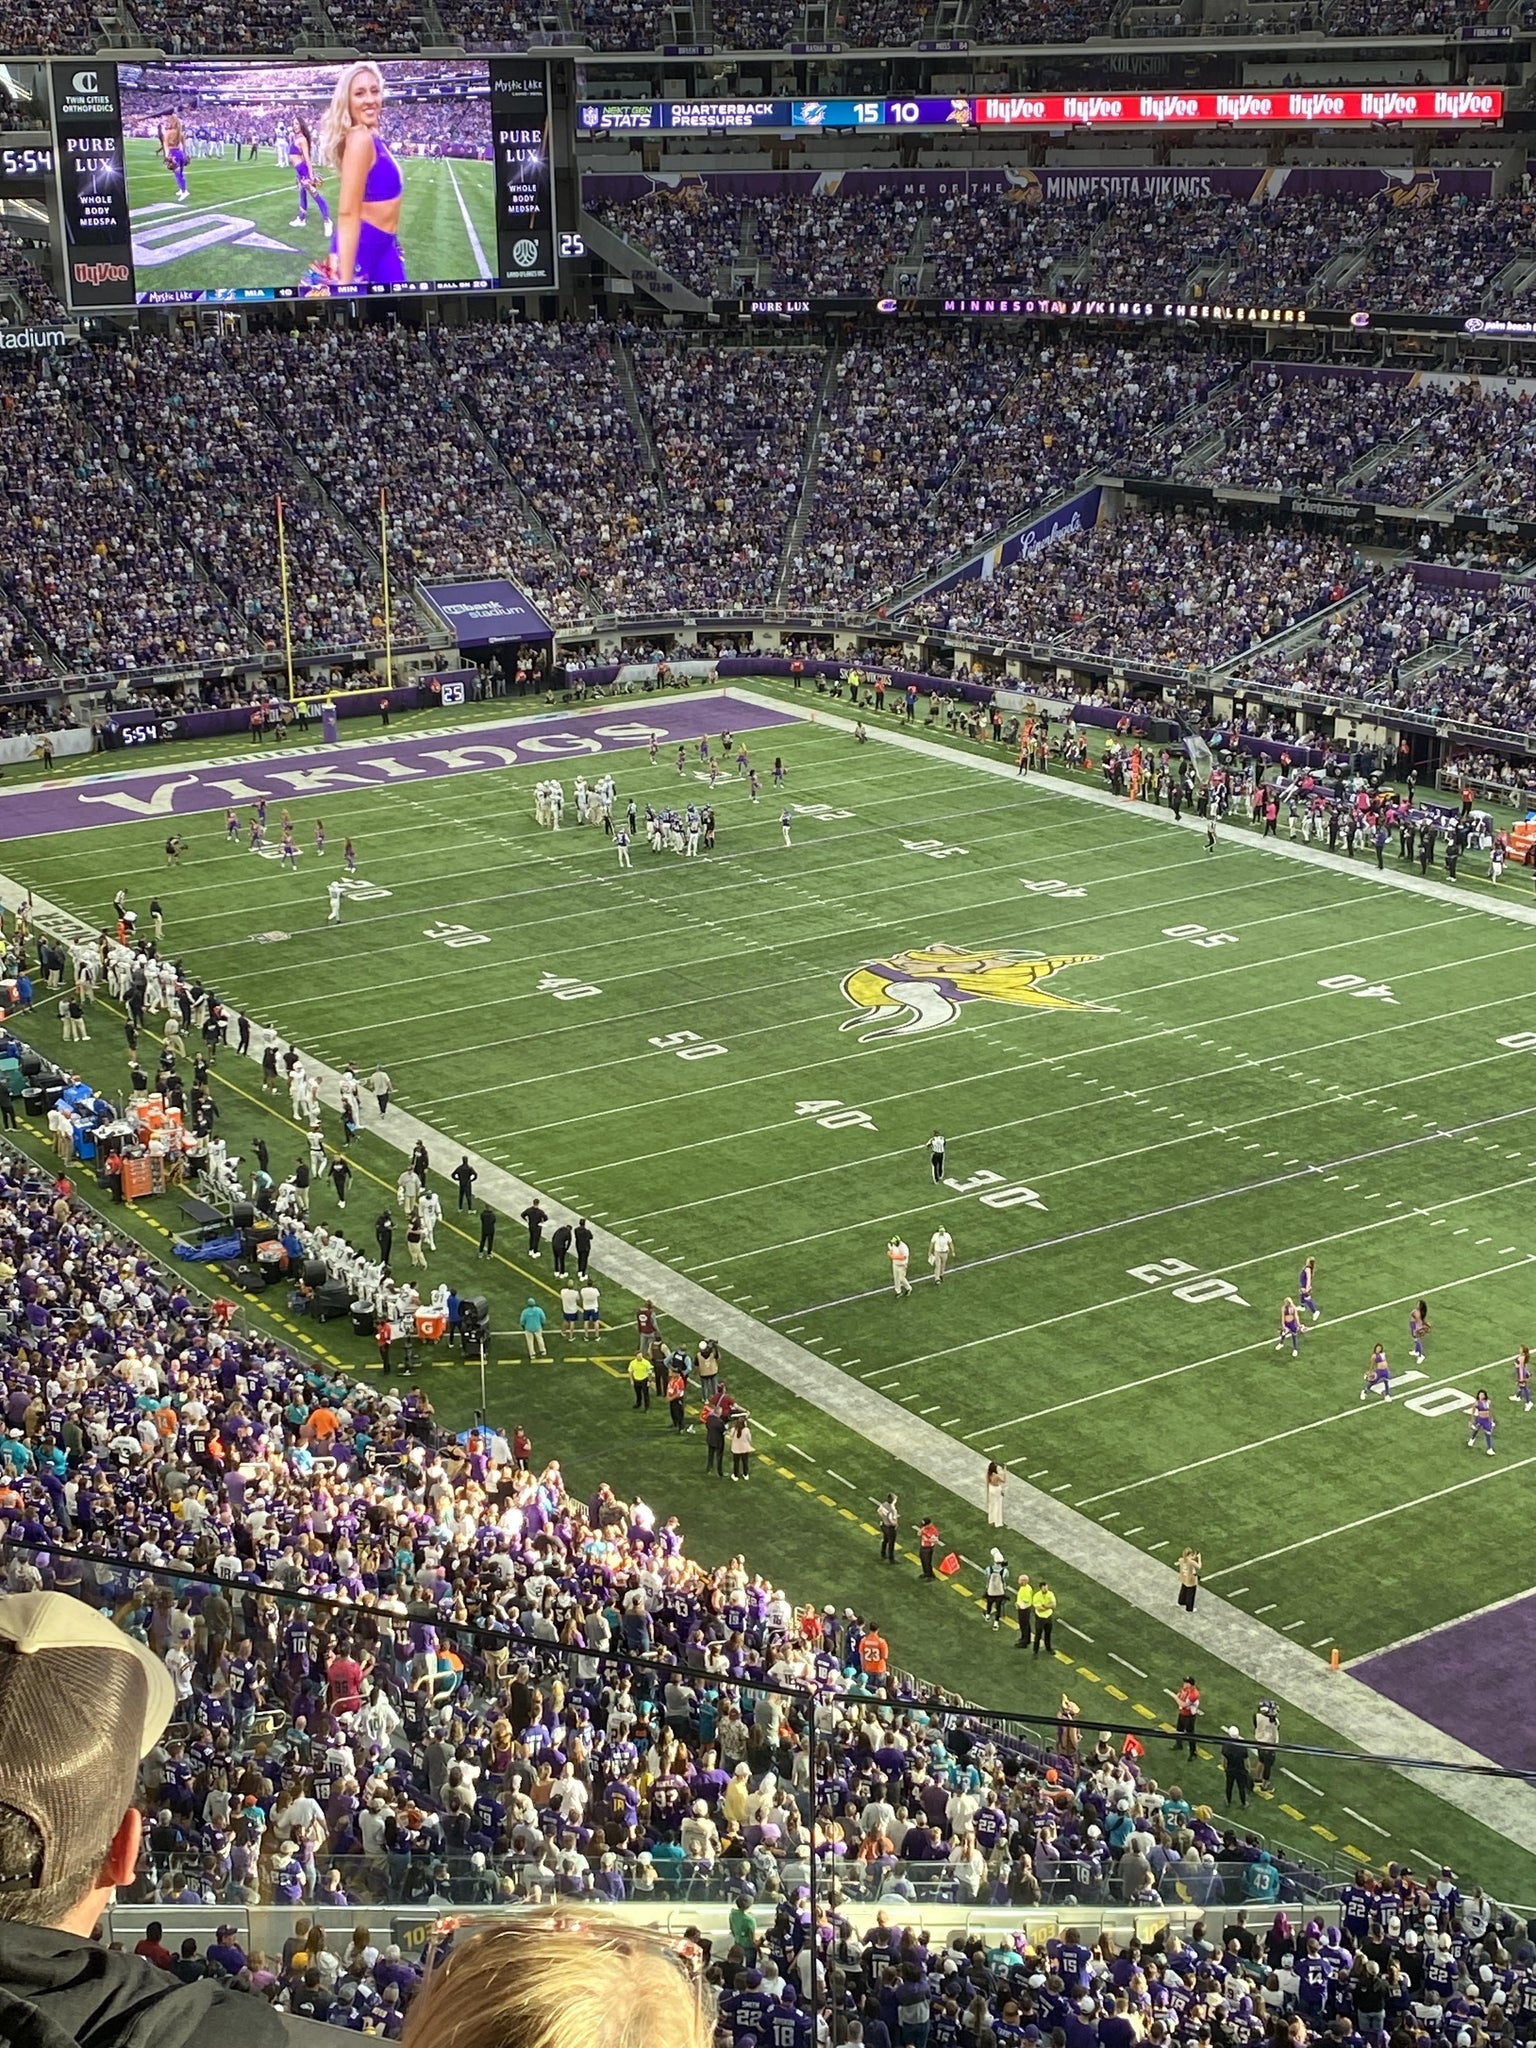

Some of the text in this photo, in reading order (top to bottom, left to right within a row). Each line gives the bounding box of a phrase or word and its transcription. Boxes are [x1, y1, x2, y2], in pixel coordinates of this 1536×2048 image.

[63, 104, 113, 112] ORTHOPEDICS
[66, 96, 85, 104] TWIN
[631, 106, 653, 114] GEN
[671, 104, 773, 115] QUARTERBACK
[853, 103, 879, 122] 15
[891, 103, 919, 122] 10
[601, 114, 650, 127] STATS
[671, 115, 752, 126] PRESSURES
[67, 138, 115, 151] PURE
[500, 130, 541, 143] PURE
[3, 150, 51, 173] 5:54
[506, 149, 538, 162] LUX
[76, 159, 113, 172] LUX
[509, 184, 536, 192] WHOLE
[940, 183, 959, 194] OF
[971, 183, 1003, 194] THE
[1047, 176, 1211, 198] MINNESOTA VIKINGS
[80, 196, 112, 204] WHOLE
[85, 207, 110, 215] BODY
[508, 205, 540, 213] MEDSPA
[80, 218, 116, 226] MEDSPA
[561, 234, 584, 255] 25
[74, 263, 129, 286] HyVee
[751, 302, 810, 312] PURE LUX
[1164, 304, 1306, 322] CHEERLEADERS
[0, 328, 66, 349] tadium
[1292, 499, 1360, 517] ticketmaster
[469, 606, 525, 619] stadium
[444, 687, 462, 702] 25
[122, 725, 157, 744] 5:54
[208, 726, 464, 767] CRUCIAL CATCH
[78, 722, 669, 815] VIKINGS
[900, 838, 970, 859] 30
[1024, 879, 1089, 898] 40
[422, 922, 493, 949] 30
[1160, 924, 1240, 948] 50
[535, 975, 603, 1001] 40
[1317, 974, 1398, 1002] 40
[647, 1030, 729, 1061] 50
[794, 1100, 874, 1129] 40
[943, 1169, 1043, 1209] 30
[1125, 1257, 1240, 1304] 20
[421, 1321, 434, 1334] G
[220, 1565, 231, 1580] 18
[592, 1575, 602, 1586] 14
[292, 1637, 306, 1654] 10
[864, 1648, 880, 1662] 23
[230, 1673, 244, 1693] 87
[316, 1783, 330, 1800] 18
[978, 1819, 997, 1833] 22
[1076, 1866, 1090, 1885] 18
[1253, 1873, 1270, 1891] 43
[1347, 1904, 1366, 1918] 22
[1031, 1924, 1056, 1943] 103
[1062, 1959, 1077, 1973] 15
[1428, 1968, 1449, 1983] 22
[736, 2009, 763, 2026] 22
[773, 2025, 796, 2048] 18
